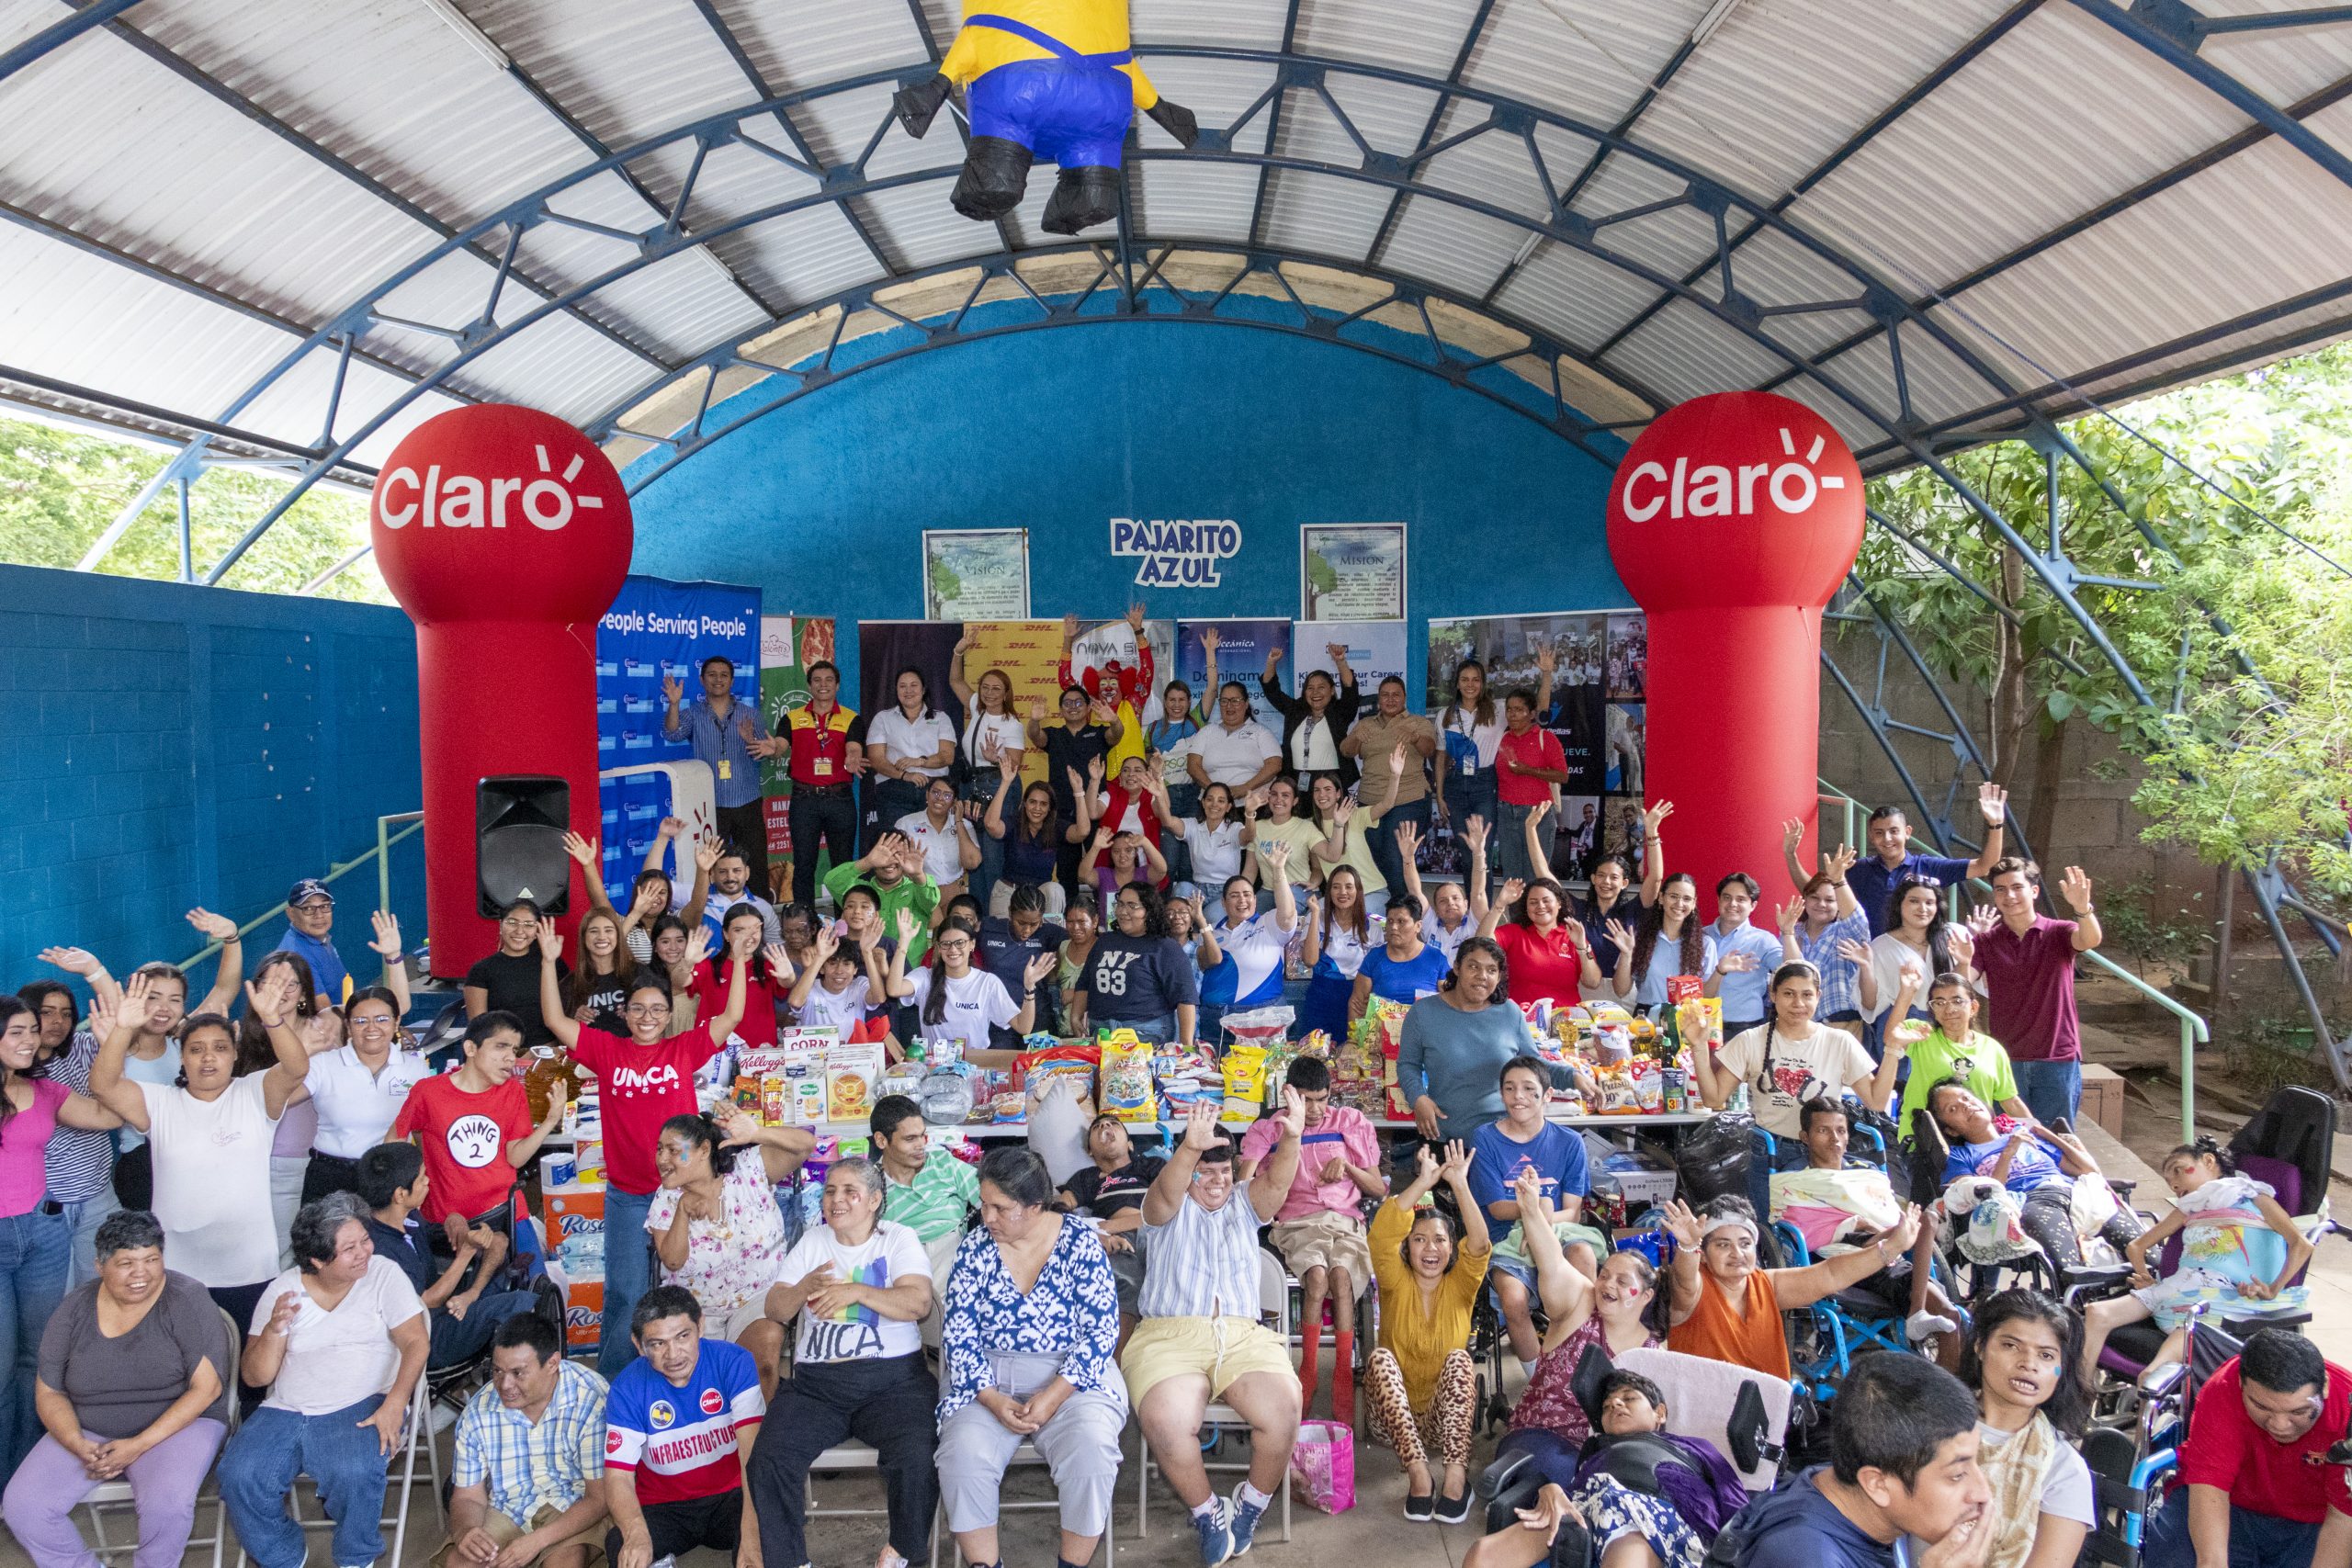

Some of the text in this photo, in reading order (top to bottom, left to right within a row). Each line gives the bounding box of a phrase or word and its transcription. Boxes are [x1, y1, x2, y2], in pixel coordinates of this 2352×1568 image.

[379, 465, 573, 530] Claro
[1623, 457, 1817, 523] Claro
[1114, 523, 1237, 554] PAJARITO
[1140, 554, 1216, 583] AZUL
[648, 613, 697, 639] Serving
[1124, 642, 1170, 655] SIHT
[767, 818, 788, 829] ESTEL
[987, 940, 1006, 948] UNICA
[1097, 951, 1141, 969] NY
[1096, 968, 1126, 996] 83
[587, 989, 625, 1008] UNIC
[956, 1001, 980, 1010] UNICA
[740, 1055, 786, 1071] Kellogg's
[612, 1064, 679, 1088] UNICA
[450, 1122, 497, 1144] THING
[469, 1143, 484, 1158] 2
[567, 1306, 603, 1327] Ros
[805, 1321, 885, 1360] NICA
[649, 1424, 737, 1466] INFRAESTRUCTUR
